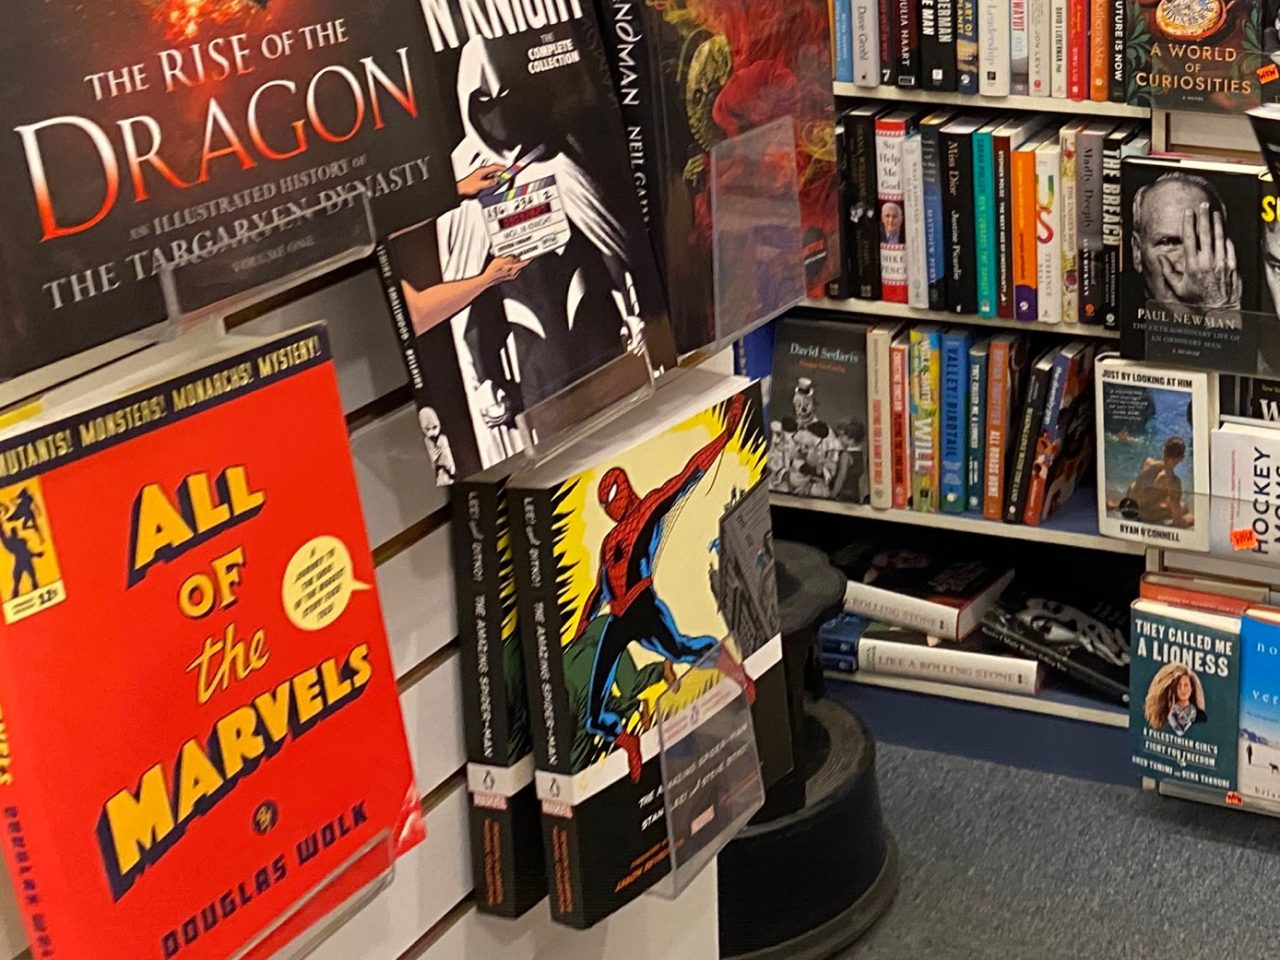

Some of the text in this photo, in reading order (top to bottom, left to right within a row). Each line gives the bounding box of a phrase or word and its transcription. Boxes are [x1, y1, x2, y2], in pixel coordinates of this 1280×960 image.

[922, 9, 935, 35] MAN
[1114, 42, 1123, 54] IS
[1151, 44, 1236, 62] A WORLD
[84, 19, 349, 100] THE RISE OF THE
[1114, 57, 1123, 81] NOW
[1136, 73, 1251, 94] CURIOSITIES
[1185, 63, 1201, 73] OF
[14, 47, 418, 242] DRAGON
[42, 259, 121, 310] THE
[125, 198, 312, 277] TARGARYEN
[319, 155, 432, 215] DYNASTY
[1137, 308, 1235, 330] PAUL NEWMAN
[80, 336, 321, 448] MONSTERS! MONARCHS! MYSTERY!
[127, 466, 266, 589] ALL
[1252, 447, 1271, 555] HOCKEY
[178, 547, 248, 620] OF
[185, 624, 271, 706] the
[1136, 619, 1232, 656] THEY CALLED ME
[1137, 637, 1229, 677] A LIONESS
[96, 643, 373, 903] MARVELS
[161, 799, 370, 960] DOUGLAS WOLK
